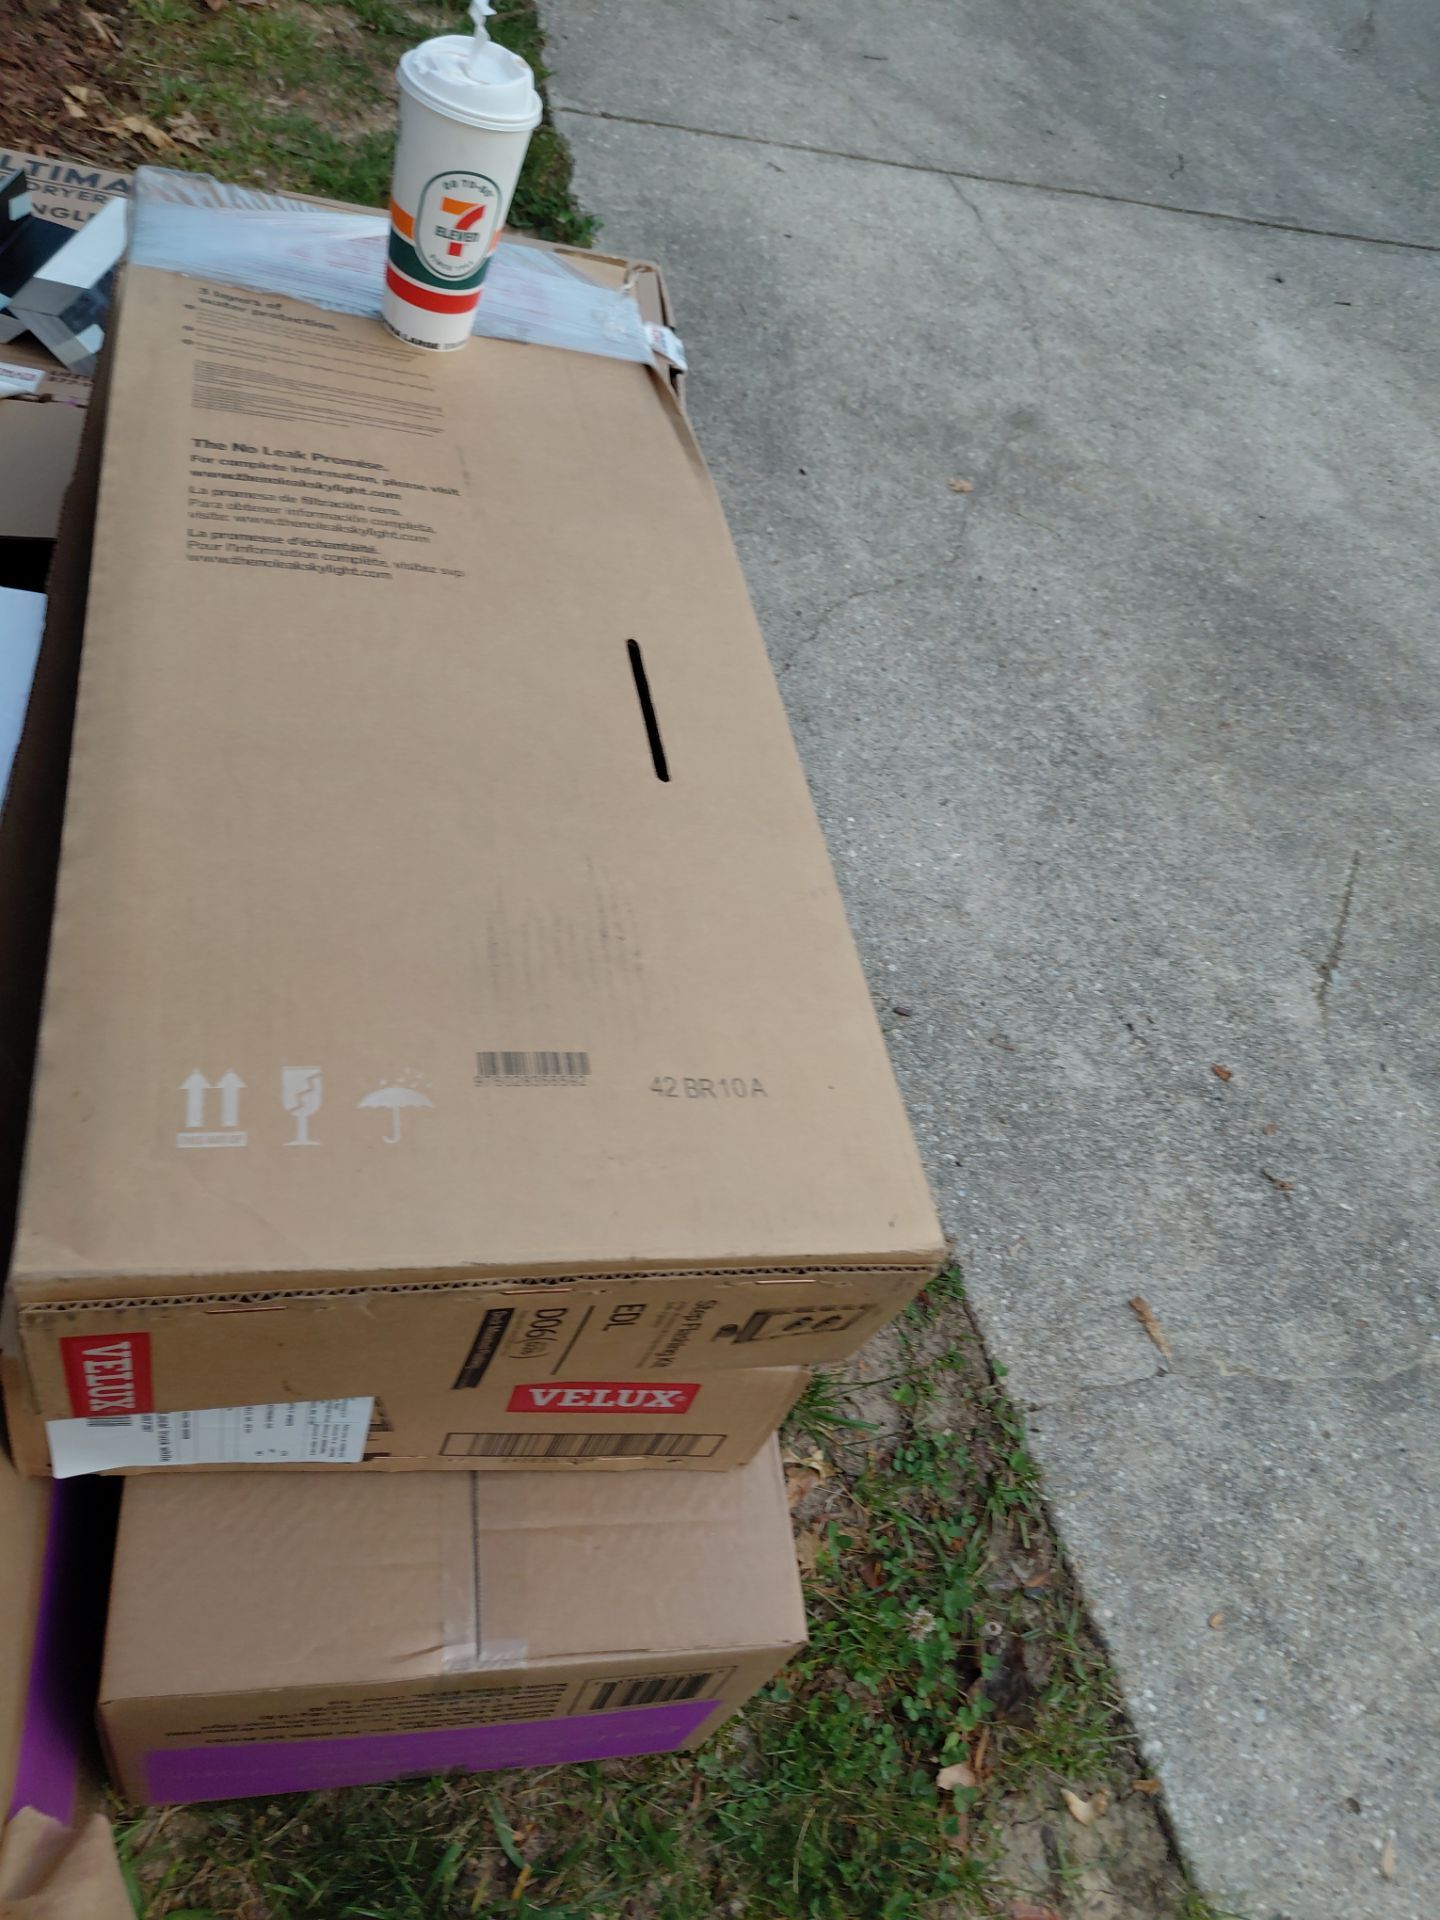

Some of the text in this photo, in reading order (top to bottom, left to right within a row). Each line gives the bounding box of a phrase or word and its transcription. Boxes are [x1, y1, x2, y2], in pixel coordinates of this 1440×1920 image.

[440, 196, 487, 257] 7
[190, 437, 228, 451] The
[231, 442, 259, 454] No
[262, 446, 307, 460] Leak
[189, 454, 215, 464] For
[217, 458, 288, 473] complete
[382, 479, 428, 491] please
[187, 498, 223, 509] Para
[188, 485, 208, 495] La
[210, 488, 277, 502] promesa
[278, 495, 299, 504] de
[185, 540, 222, 552] Pour
[186, 528, 208, 538] La
[209, 531, 285, 545] promesse
[602, 1303, 648, 1332] EDL
[81, 1341, 136, 1412] VELUX
[529, 1388, 684, 1408] VELUX
